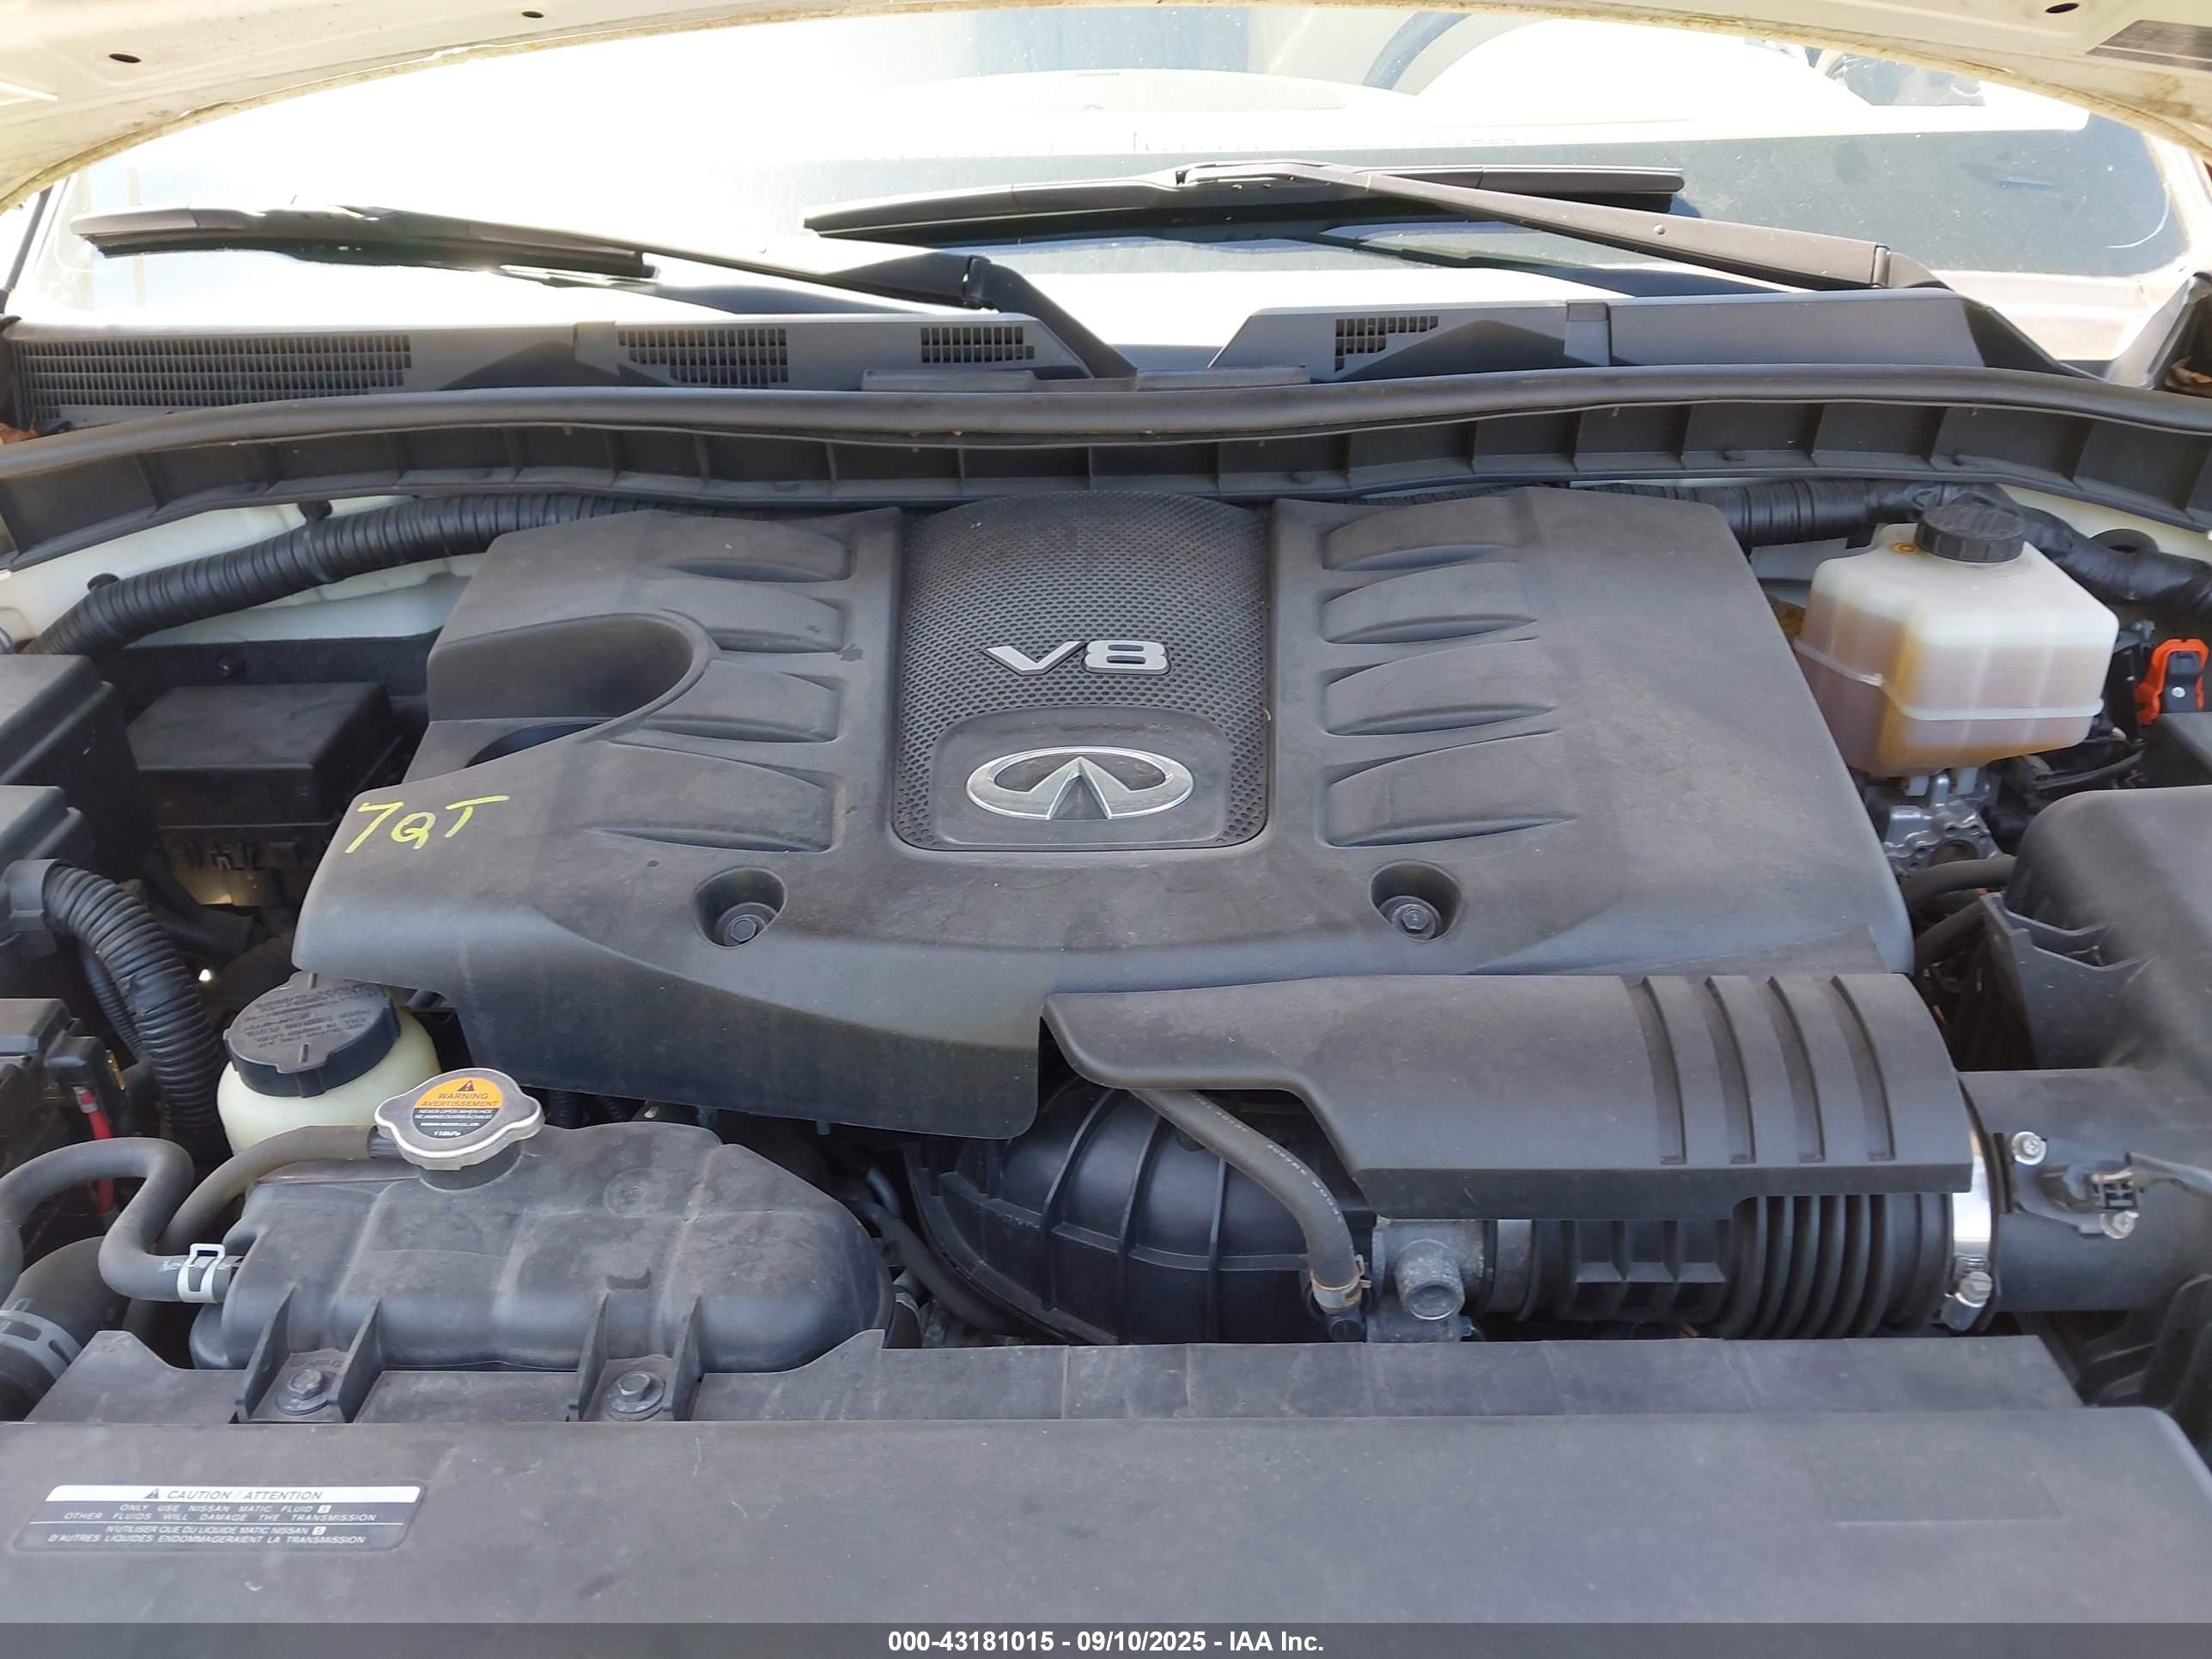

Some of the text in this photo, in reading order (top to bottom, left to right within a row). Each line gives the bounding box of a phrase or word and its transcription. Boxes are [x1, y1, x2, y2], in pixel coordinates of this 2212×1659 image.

[984, 640, 1170, 675] V8
[167, 1490, 232, 1499] CAUTION
[244, 1491, 324, 1500] ATTENTION
[267, 1535, 281, 1544] LA
